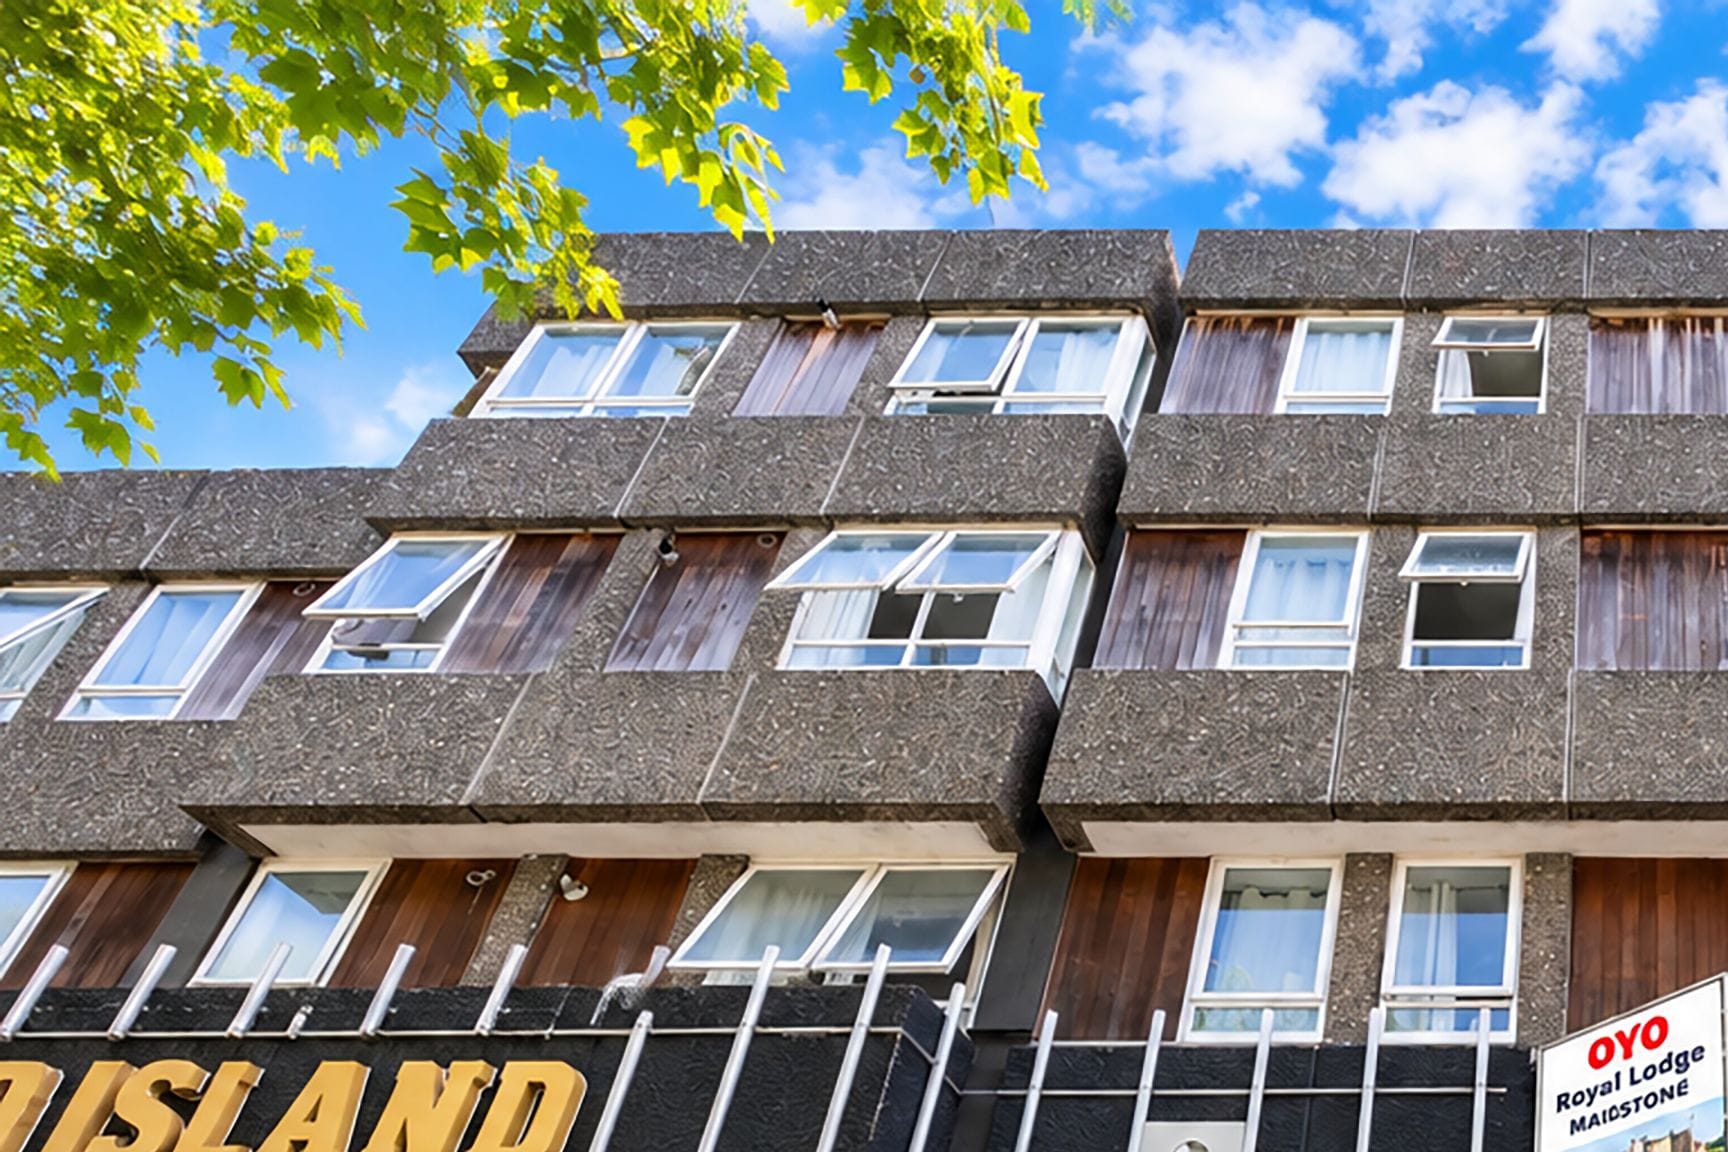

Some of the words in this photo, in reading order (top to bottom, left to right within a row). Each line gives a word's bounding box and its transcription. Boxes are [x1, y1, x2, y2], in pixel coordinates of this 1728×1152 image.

[1588, 1015, 1669, 1070] OYO
[1556, 1071, 1621, 1113] Royal
[1629, 1045, 1706, 1086] Lodge
[1569, 1078, 1690, 1136] MAIDSTONE
